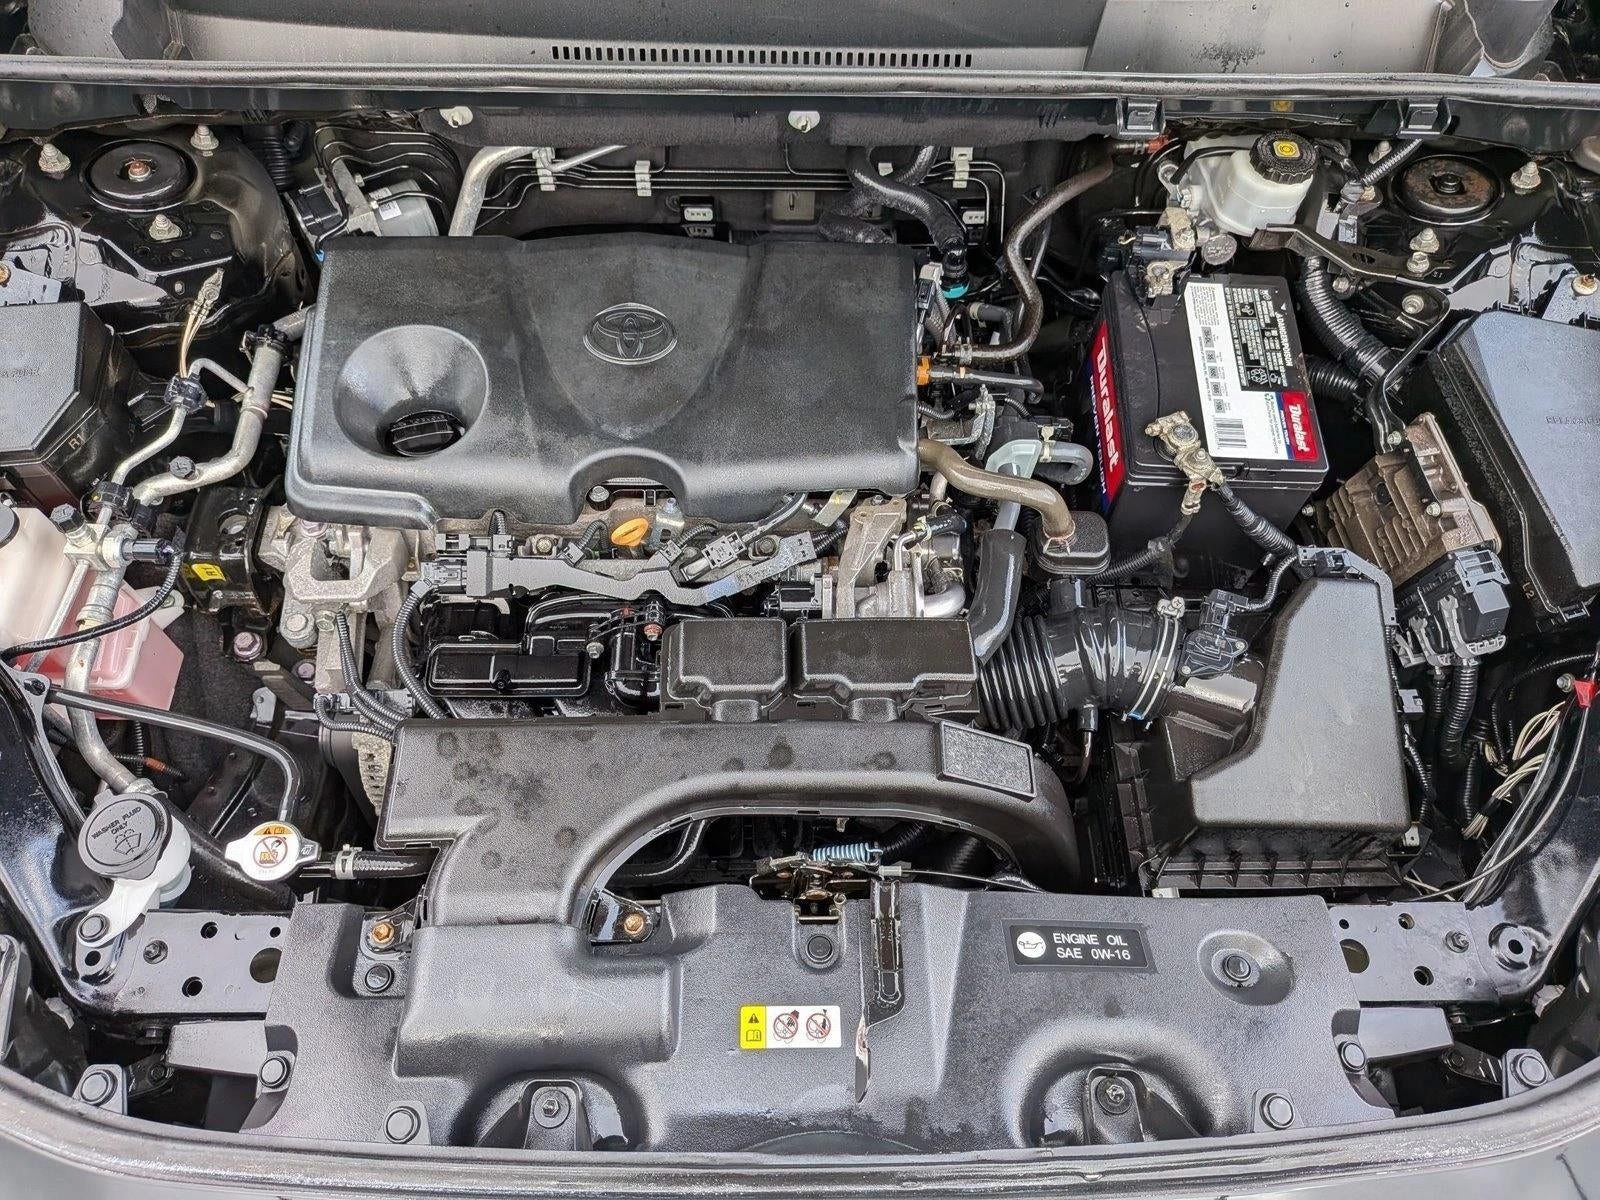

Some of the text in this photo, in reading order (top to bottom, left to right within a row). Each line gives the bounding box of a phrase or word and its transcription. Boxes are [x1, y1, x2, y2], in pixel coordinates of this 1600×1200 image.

[1097, 336, 1119, 473] Duralast
[1288, 403, 1311, 452] Duralast
[91, 806, 142, 839] WASHER FLUID
[111, 821, 128, 834] ONLY
[1052, 932, 1128, 946] ENGINE OIL
[1056, 947, 1131, 961] SAE 0W-16
